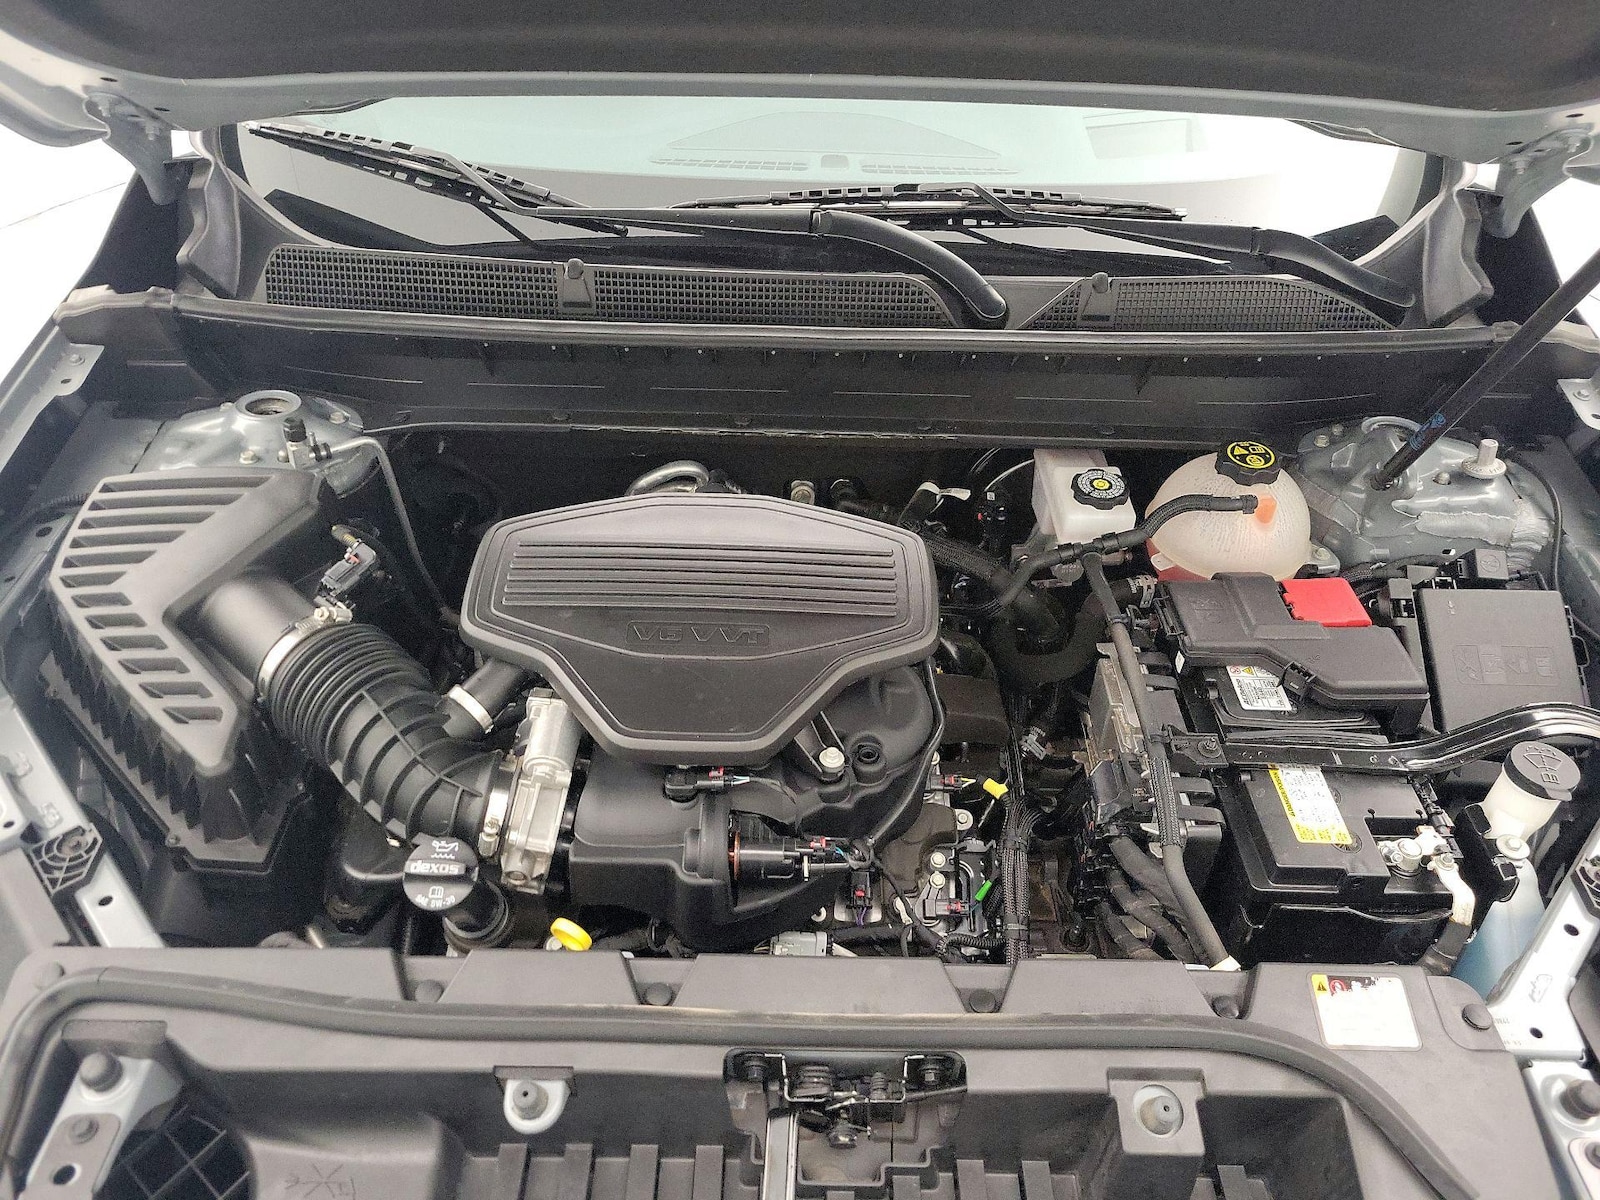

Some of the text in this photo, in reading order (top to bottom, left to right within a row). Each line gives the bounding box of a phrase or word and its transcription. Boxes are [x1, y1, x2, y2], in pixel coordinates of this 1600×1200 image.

[633, 625, 765, 643] V6 VVT
[410, 860, 459, 875] dexos
